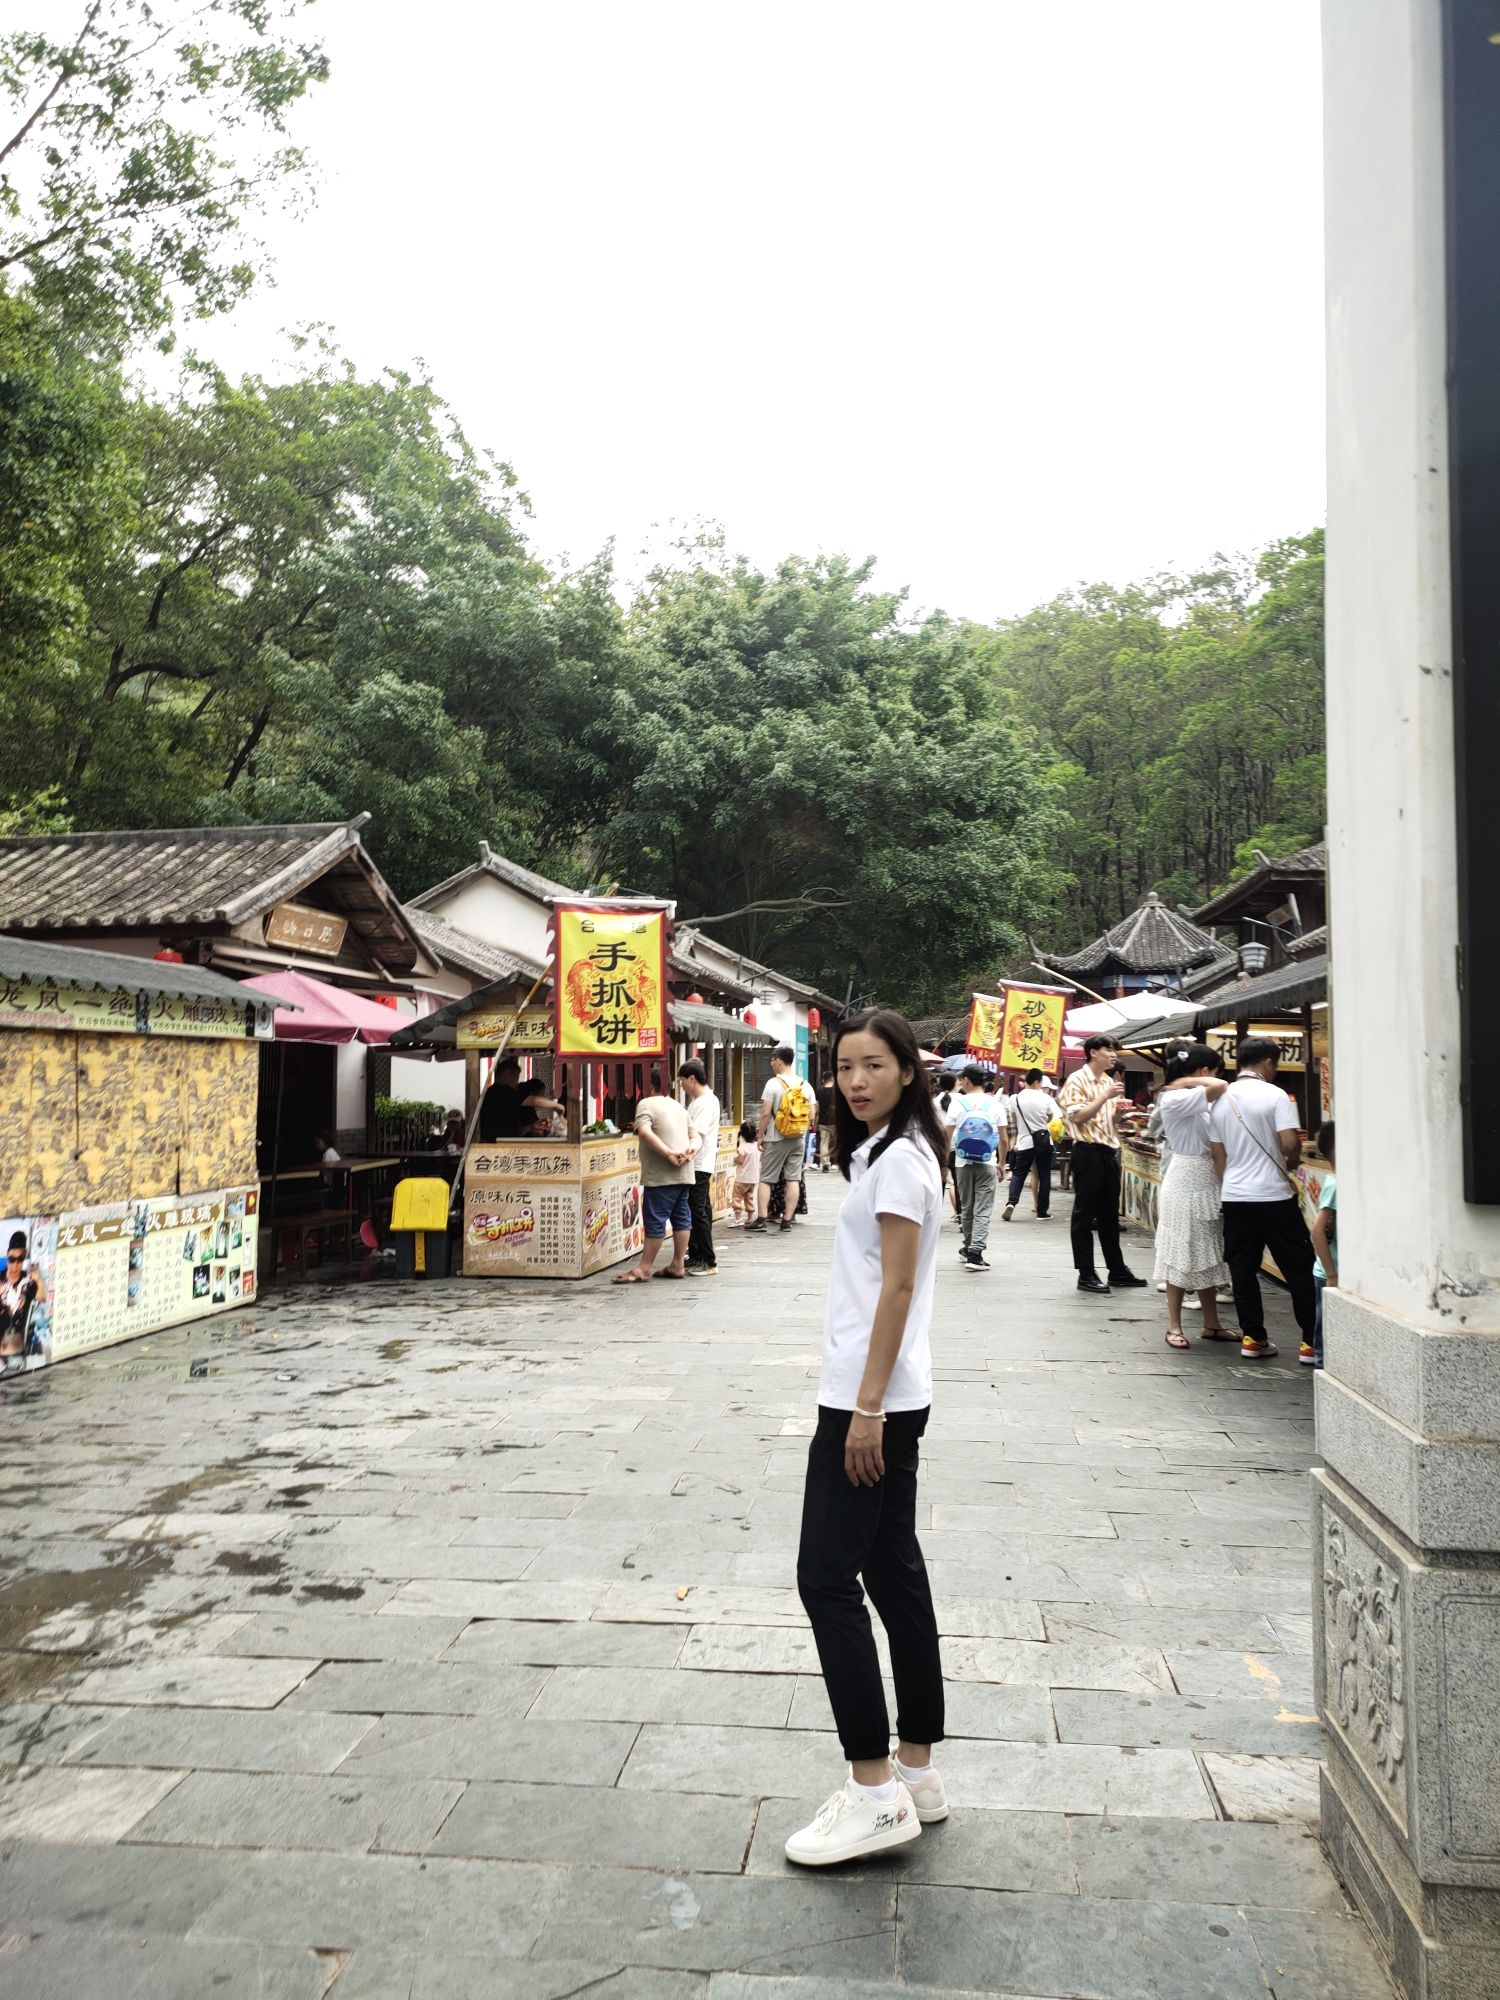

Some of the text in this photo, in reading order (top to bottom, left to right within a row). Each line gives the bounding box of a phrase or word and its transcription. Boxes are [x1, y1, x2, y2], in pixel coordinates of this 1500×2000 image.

[589, 941, 637, 1045] 手抓饼
[510, 1021, 556, 1037] 原味
[1017, 1000, 1046, 1063] 砂锅粉
[1217, 1034, 1301, 1062] 花粉
[474, 1155, 572, 1175] 台湾手抓饼
[470, 1190, 532, 1204] 原味6元
[57, 1216, 135, 1247] 龙凤一绝
[146, 1205, 213, 1232] 火雕玻璃
